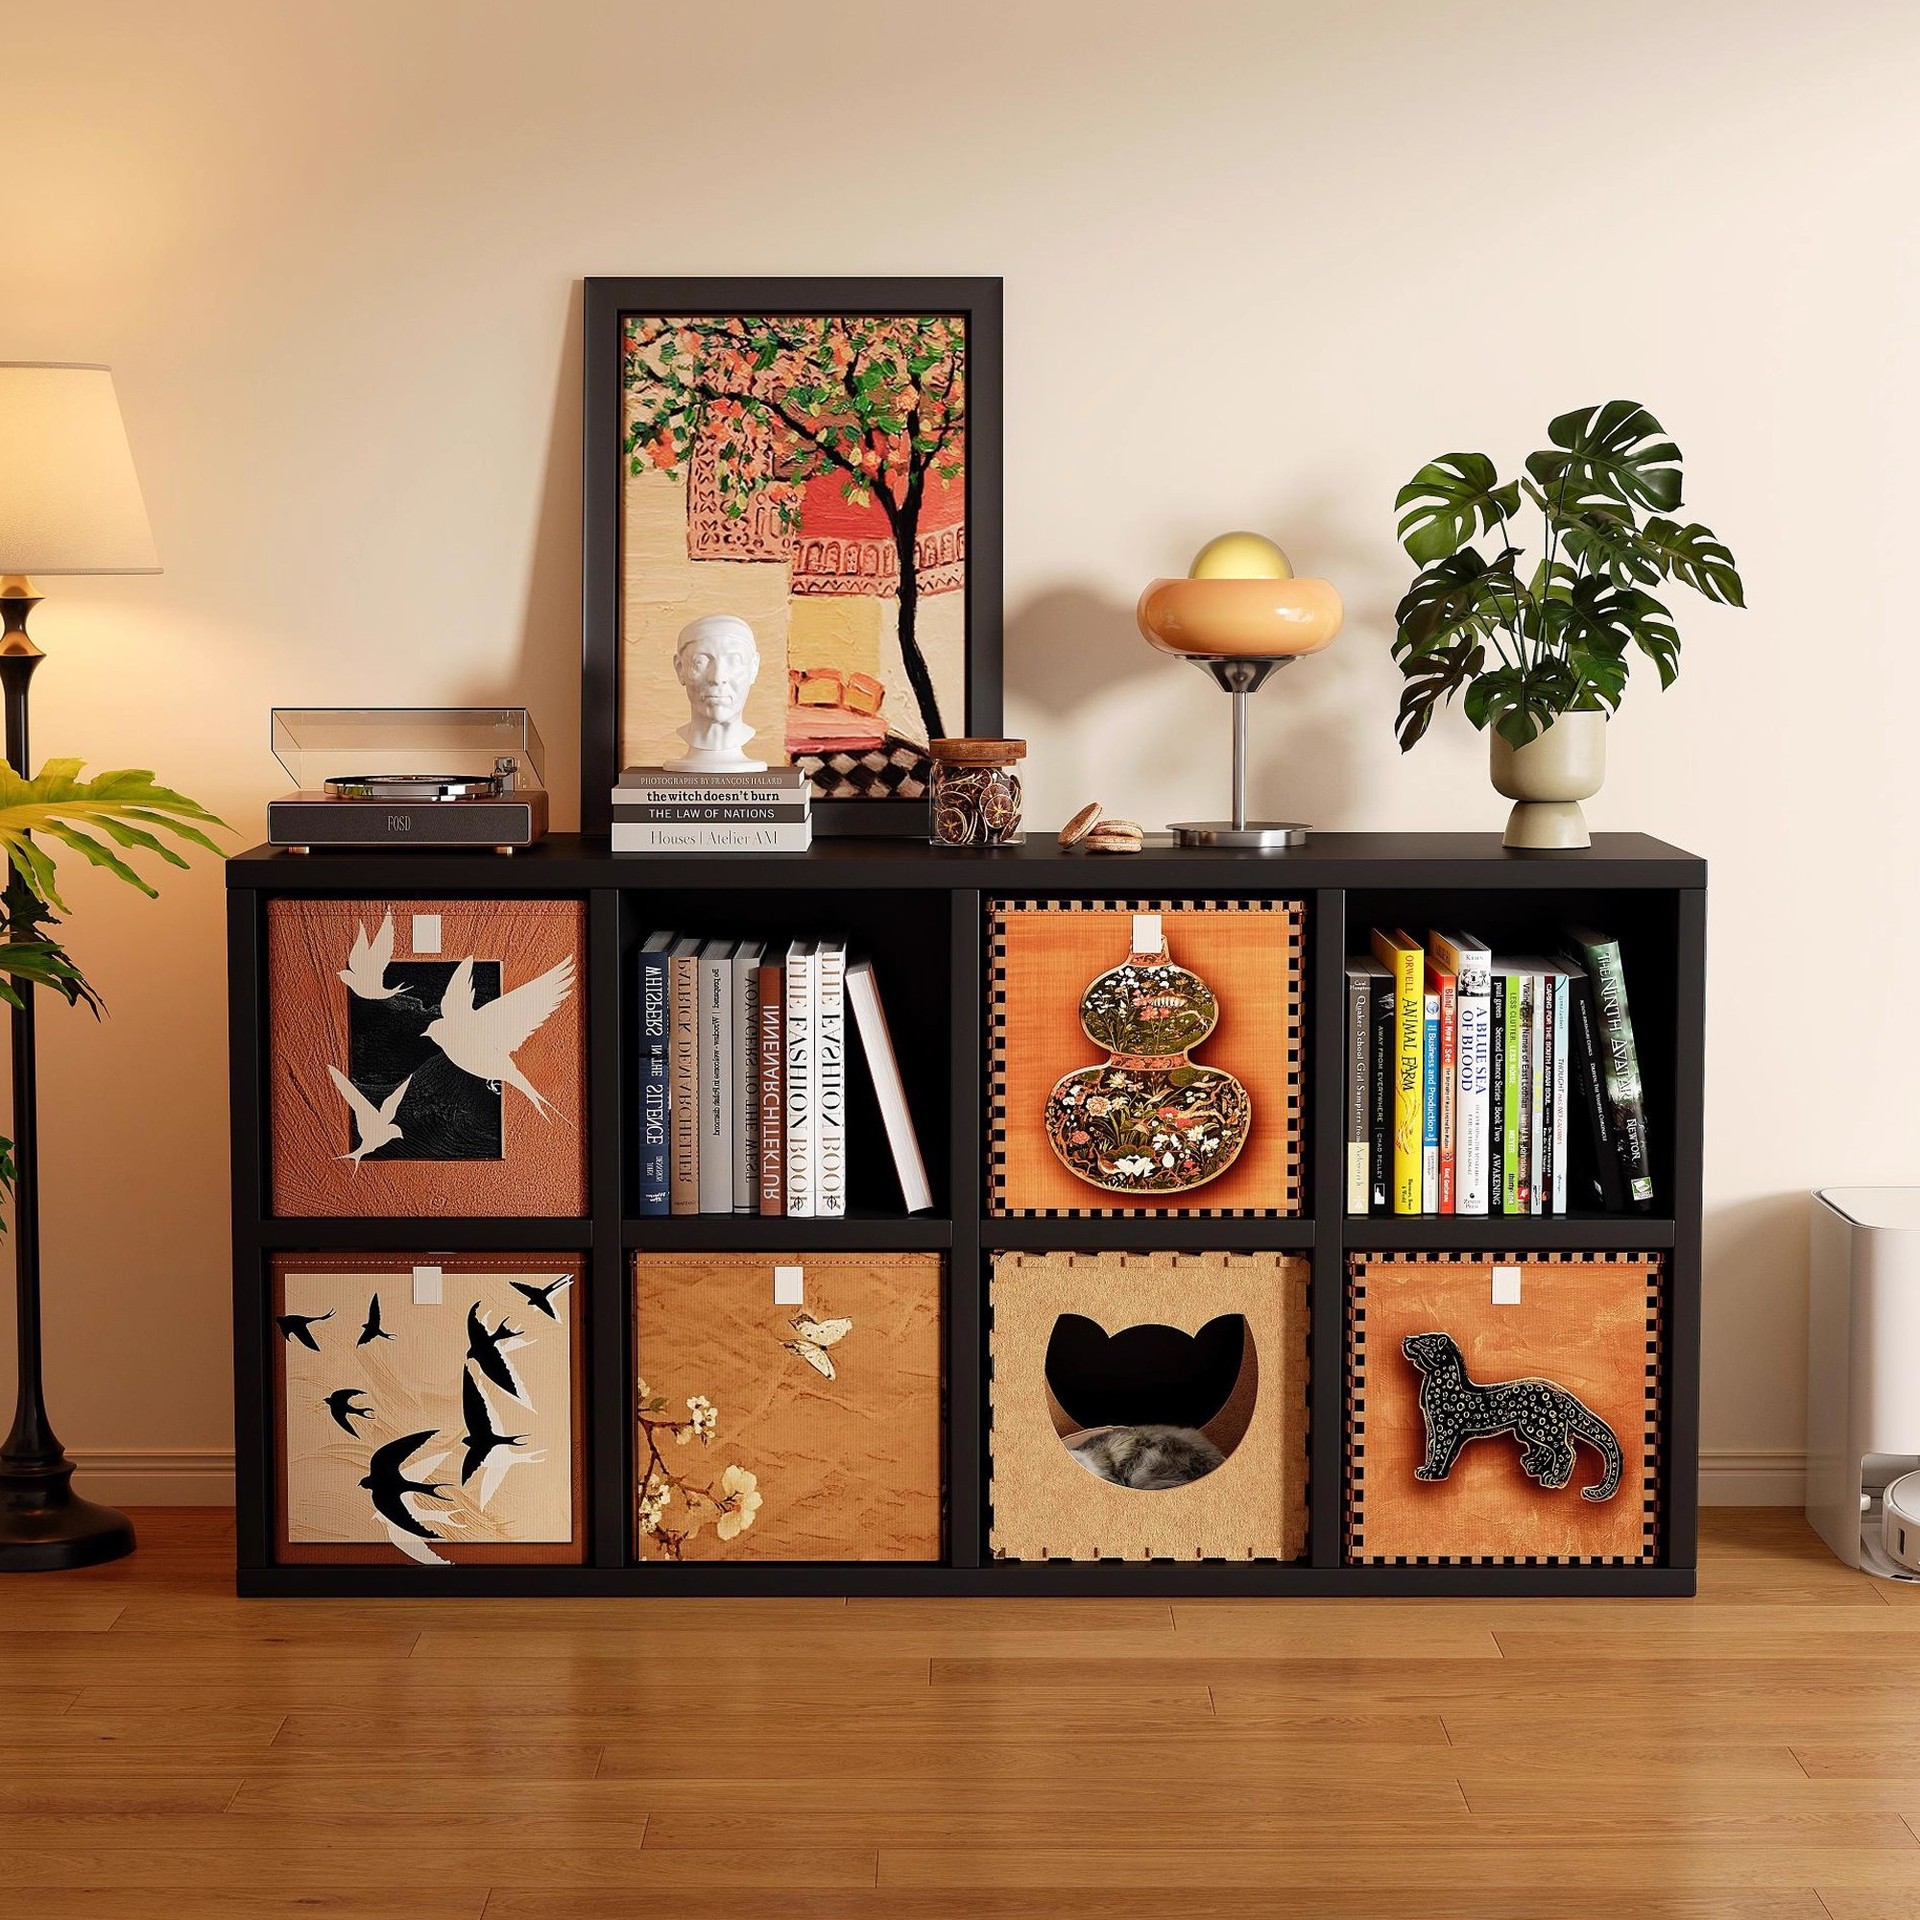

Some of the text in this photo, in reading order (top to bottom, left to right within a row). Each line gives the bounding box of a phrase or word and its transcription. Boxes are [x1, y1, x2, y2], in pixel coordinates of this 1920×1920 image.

[640, 777, 699, 785] PHOTOGRAPHS
[701, 777, 710, 785] BY
[751, 777, 783, 785] HALARD
[647, 790, 780, 802] the witch doesn't burn
[387, 815, 411, 831] FOSD
[649, 808, 775, 819] THE LAW OF NATIONS
[651, 830, 778, 845] Houses Atelier AM
[789, 955, 807, 1008] THE
[1521, 983, 1530, 1006] Viking
[1355, 995, 1366, 1028] Quaker
[1401, 955, 1418, 1091] ORWELL ANIMAL FARM
[1444, 1010, 1453, 1024] But
[1597, 952, 1633, 1102] THE NINTH AVATAR
[1356, 1030, 1366, 1060] School
[1444, 1048, 1452, 1063] See
[1462, 1010, 1474, 1092] OF BLOOD
[1475, 1007, 1487, 1095] A BLUE SEA
[1522, 1029, 1530, 1053] Names
[789, 1016, 807, 1129] FASHION
[1356, 1063, 1366, 1082] Girl
[1494, 982, 1503, 1142] paul green Second Chance Series Book Two
[1521, 1054, 1529, 1063] of
[1521, 1064, 1529, 1080] East
[1427, 1033, 1436, 1132] Business and Production
[1557, 1058, 1565, 1094] THOUGHT
[1355, 1085, 1366, 1123] Samplers
[1376, 1071, 1384, 1123] EVERYWHERE
[1626, 1118, 1641, 1162] NEWTON
[1492, 1153, 1501, 1206] AWAKENING
